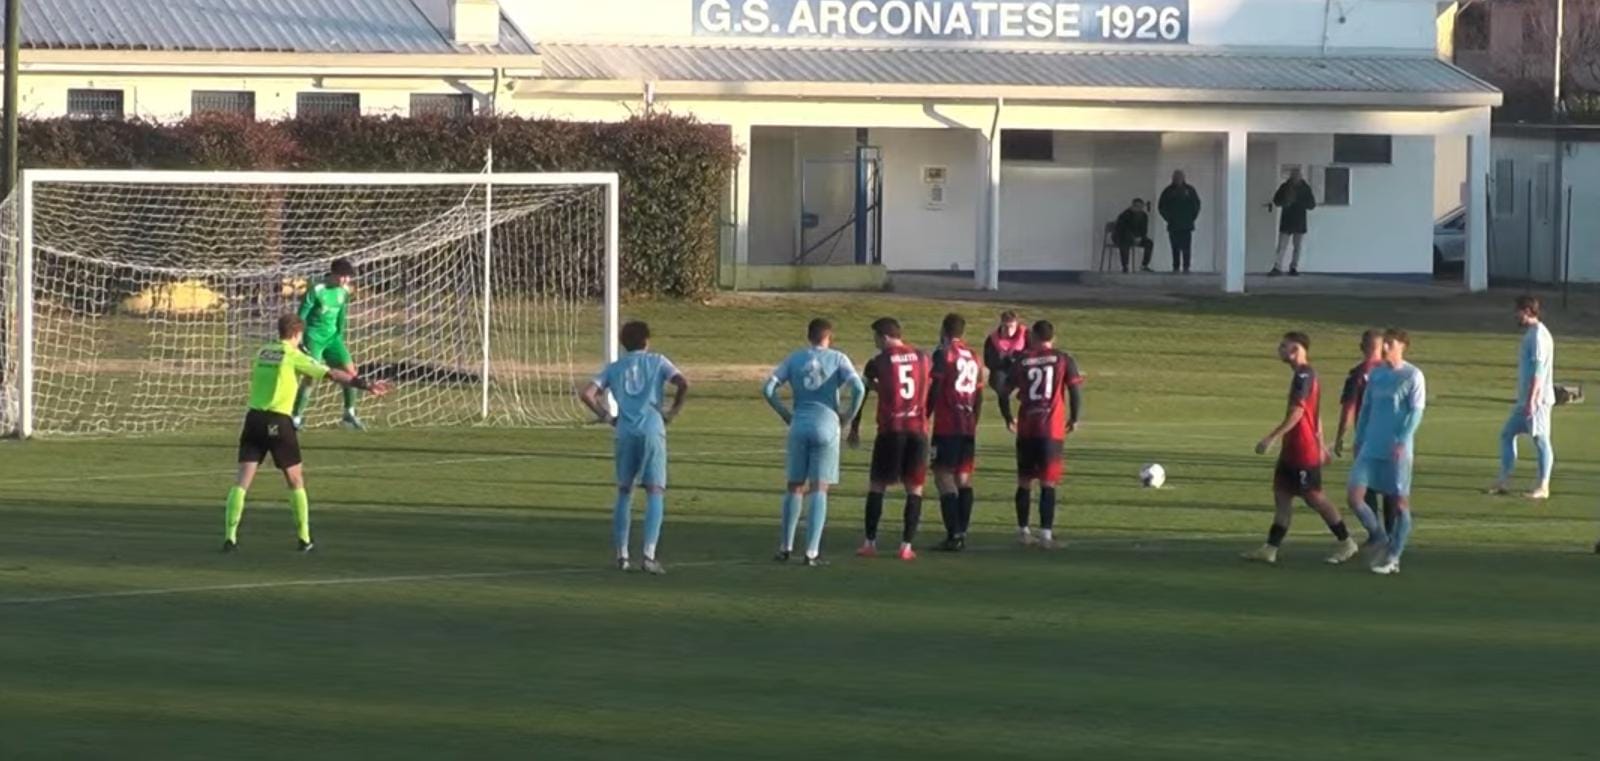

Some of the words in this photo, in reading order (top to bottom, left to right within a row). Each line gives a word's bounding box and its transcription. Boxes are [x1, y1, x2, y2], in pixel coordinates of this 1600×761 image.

[699, 0, 780, 33] G.S.
[787, 0, 1080, 38] ARCONATESE
[1095, 5, 1182, 41] 1926
[898, 364, 915, 400] 5
[954, 357, 979, 395] 29
[1027, 364, 1054, 401] 21
